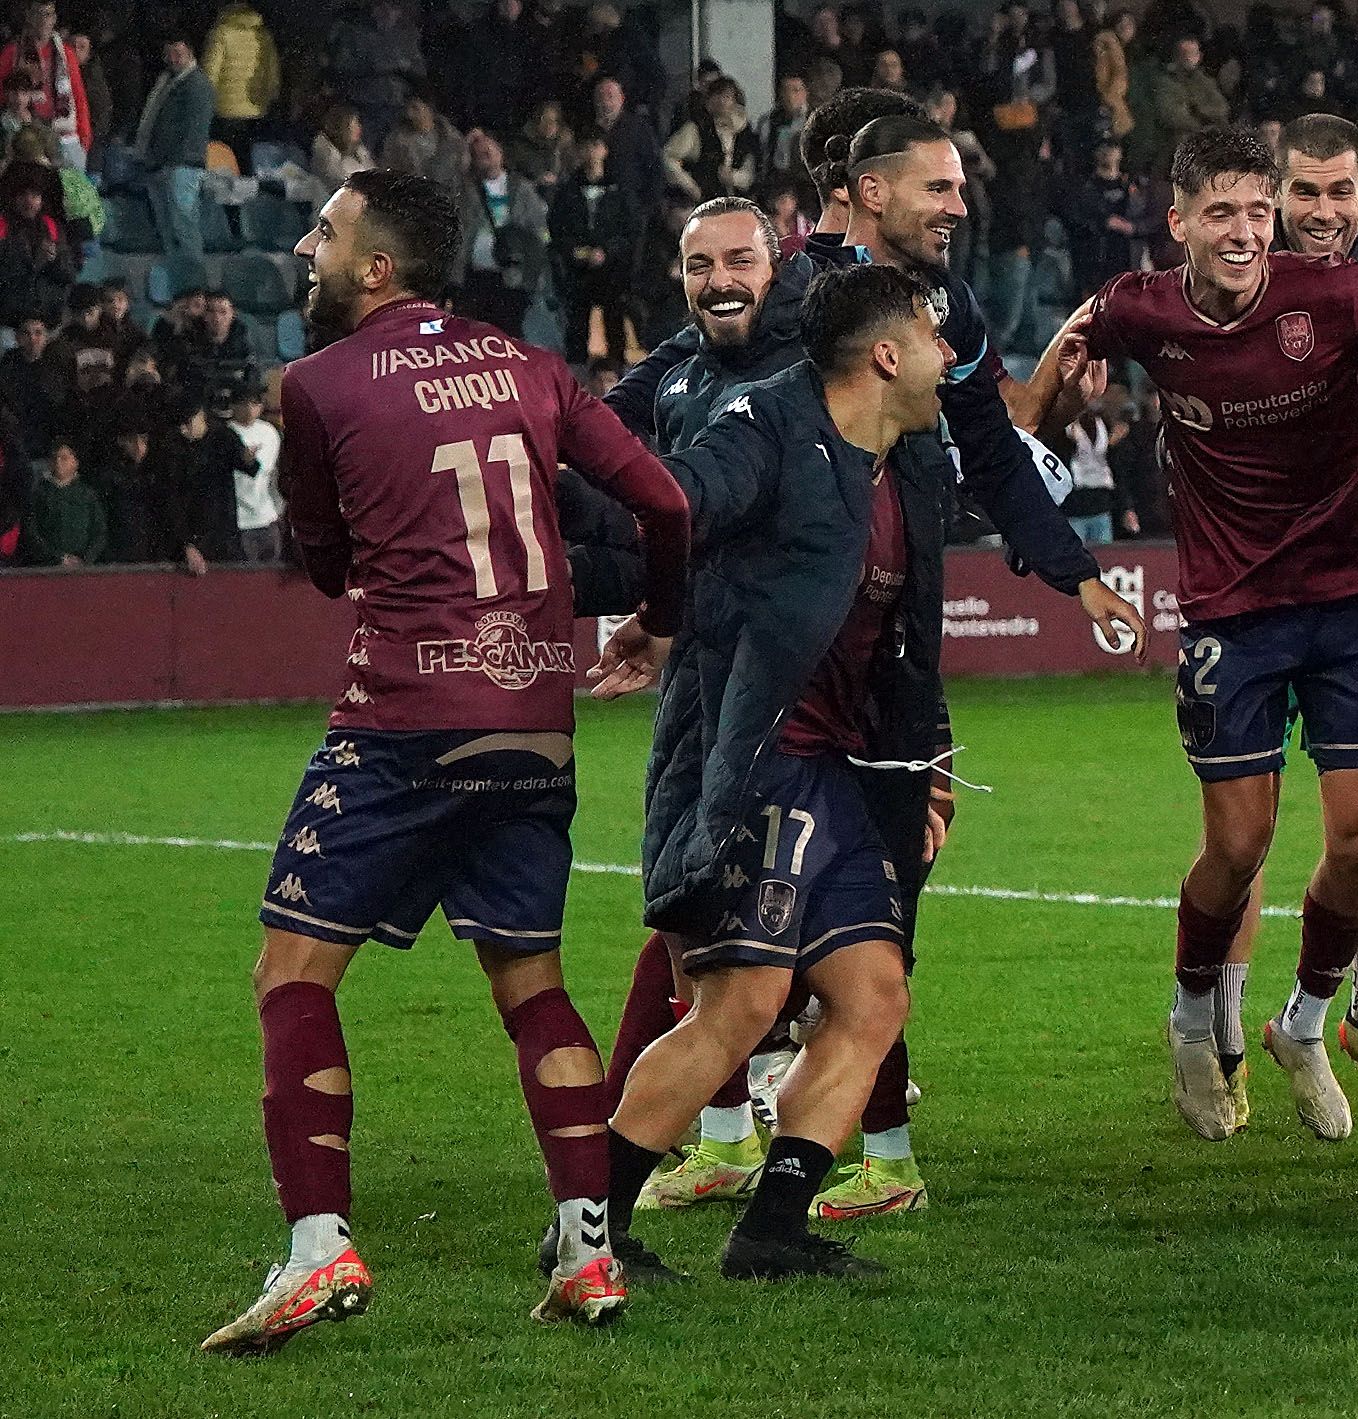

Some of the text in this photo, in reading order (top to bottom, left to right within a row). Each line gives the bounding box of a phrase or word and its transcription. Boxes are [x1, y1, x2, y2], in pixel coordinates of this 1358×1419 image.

[414, 368, 520, 414] CHIQUI
[431, 433, 548, 599] 11
[417, 639, 576, 674] PESCAMAR
[1194, 636, 1222, 695] 2
[760, 804, 816, 876] 17
[769, 1164, 808, 1179] adidas
